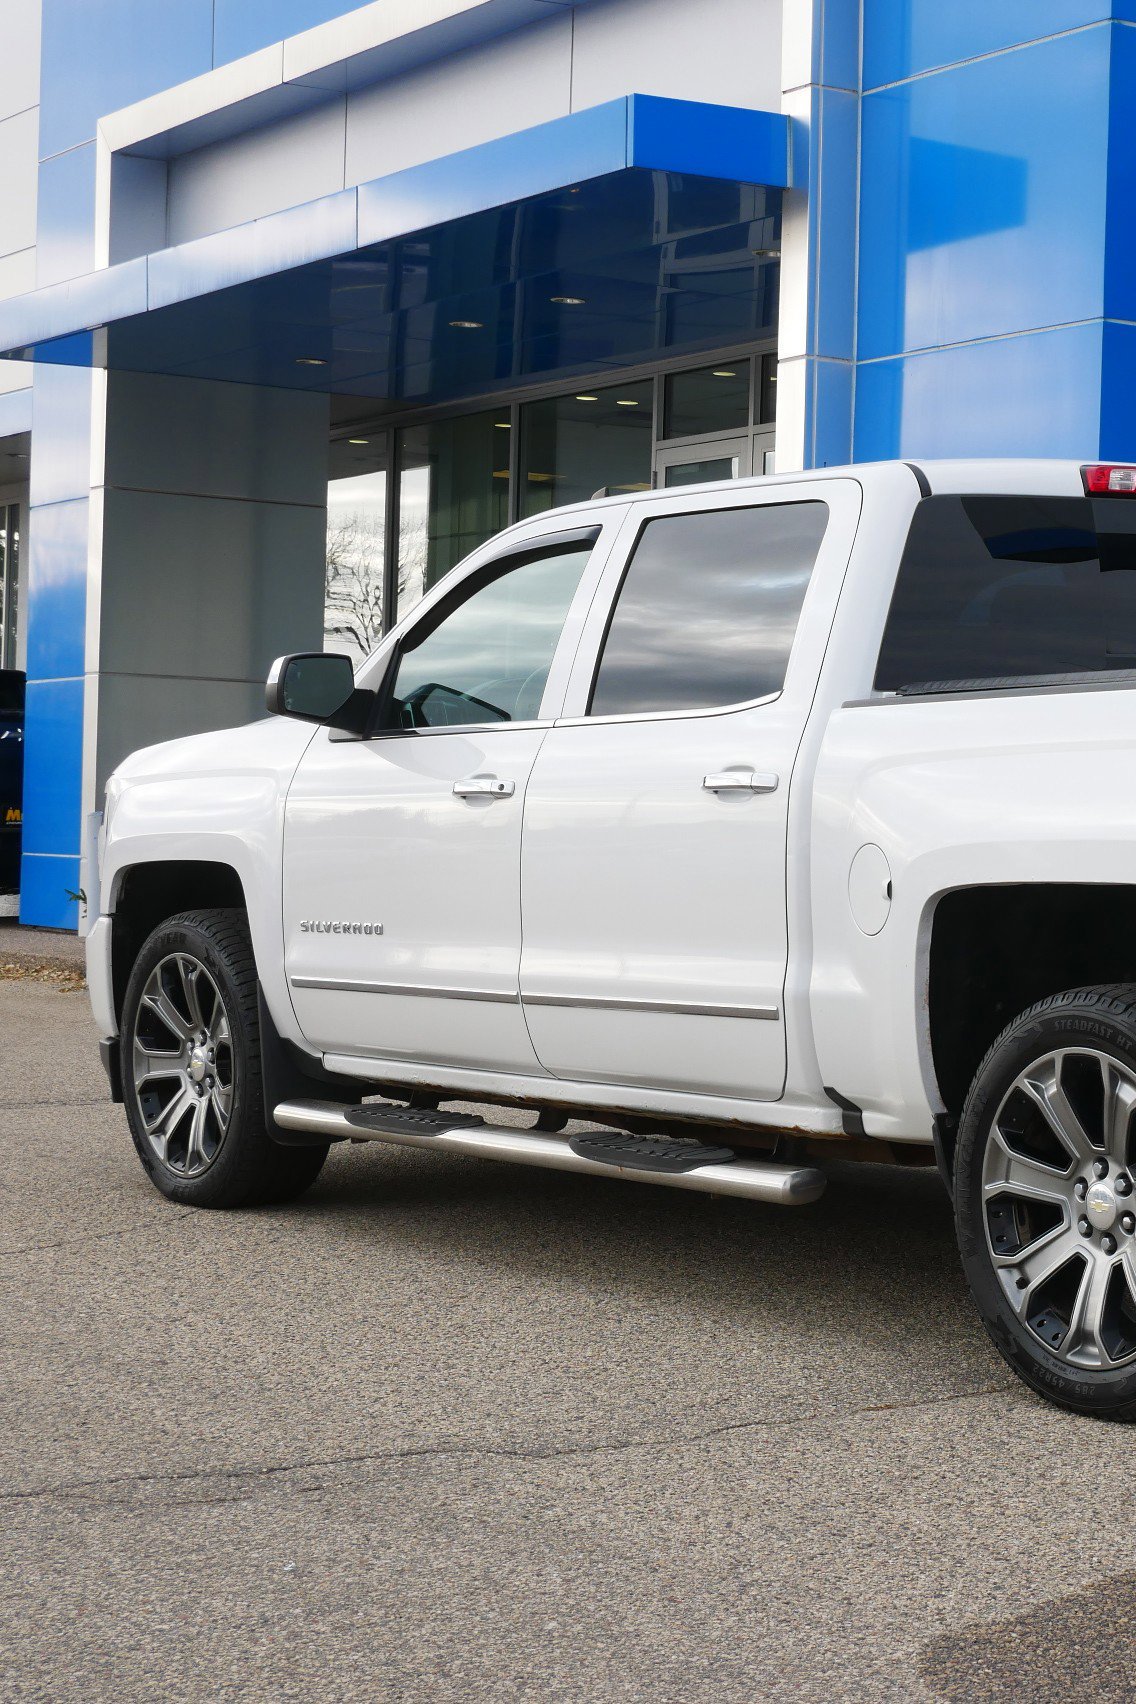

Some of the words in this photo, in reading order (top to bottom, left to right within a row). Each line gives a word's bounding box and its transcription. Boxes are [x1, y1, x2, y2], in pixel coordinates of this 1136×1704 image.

[300, 920, 384, 935] SILVERADO
[1054, 1019, 1114, 1039] STEADFAST
[1116, 1034, 1133, 1050] HT
